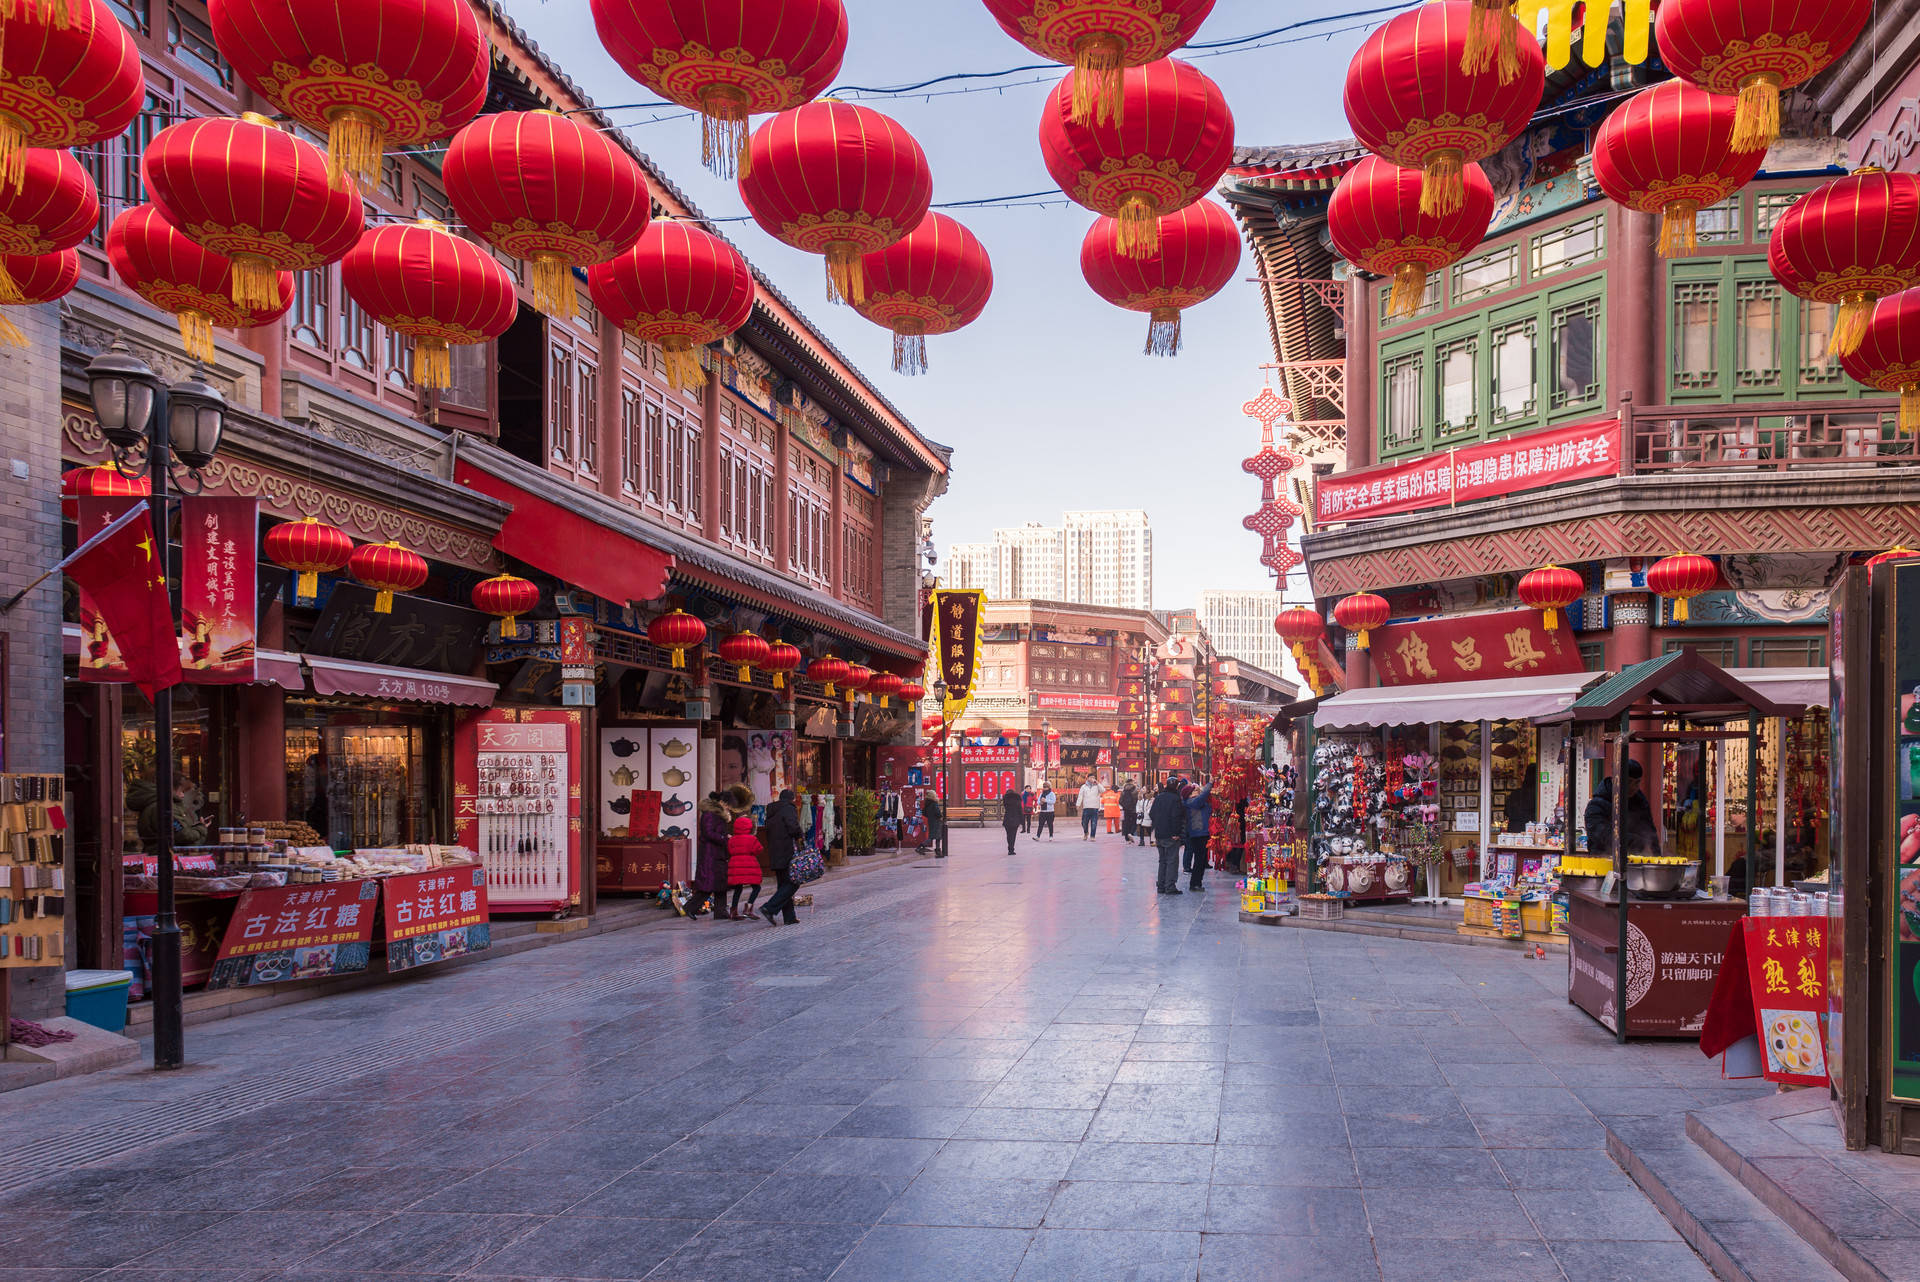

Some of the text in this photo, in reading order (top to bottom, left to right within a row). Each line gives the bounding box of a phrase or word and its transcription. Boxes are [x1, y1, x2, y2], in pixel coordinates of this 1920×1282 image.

[1320, 434, 1610, 515] 消防安全是幸福的保障 治理隐患保障消防安全
[204, 513, 220, 608] 创建文明城市
[222, 540, 237, 631] 建设美丽天津
[949, 602, 965, 679] 静道服饰
[421, 683, 450, 699] 130号
[481, 727, 544, 748] 天方阁
[284, 888, 337, 906] 天津特产
[418, 876, 455, 893] 天津特产
[243, 903, 361, 938] 古法红糖
[396, 889, 477, 923] 古法红糖
[1767, 926, 1822, 949] 天津特
[1762, 956, 1822, 999] 熟梨
